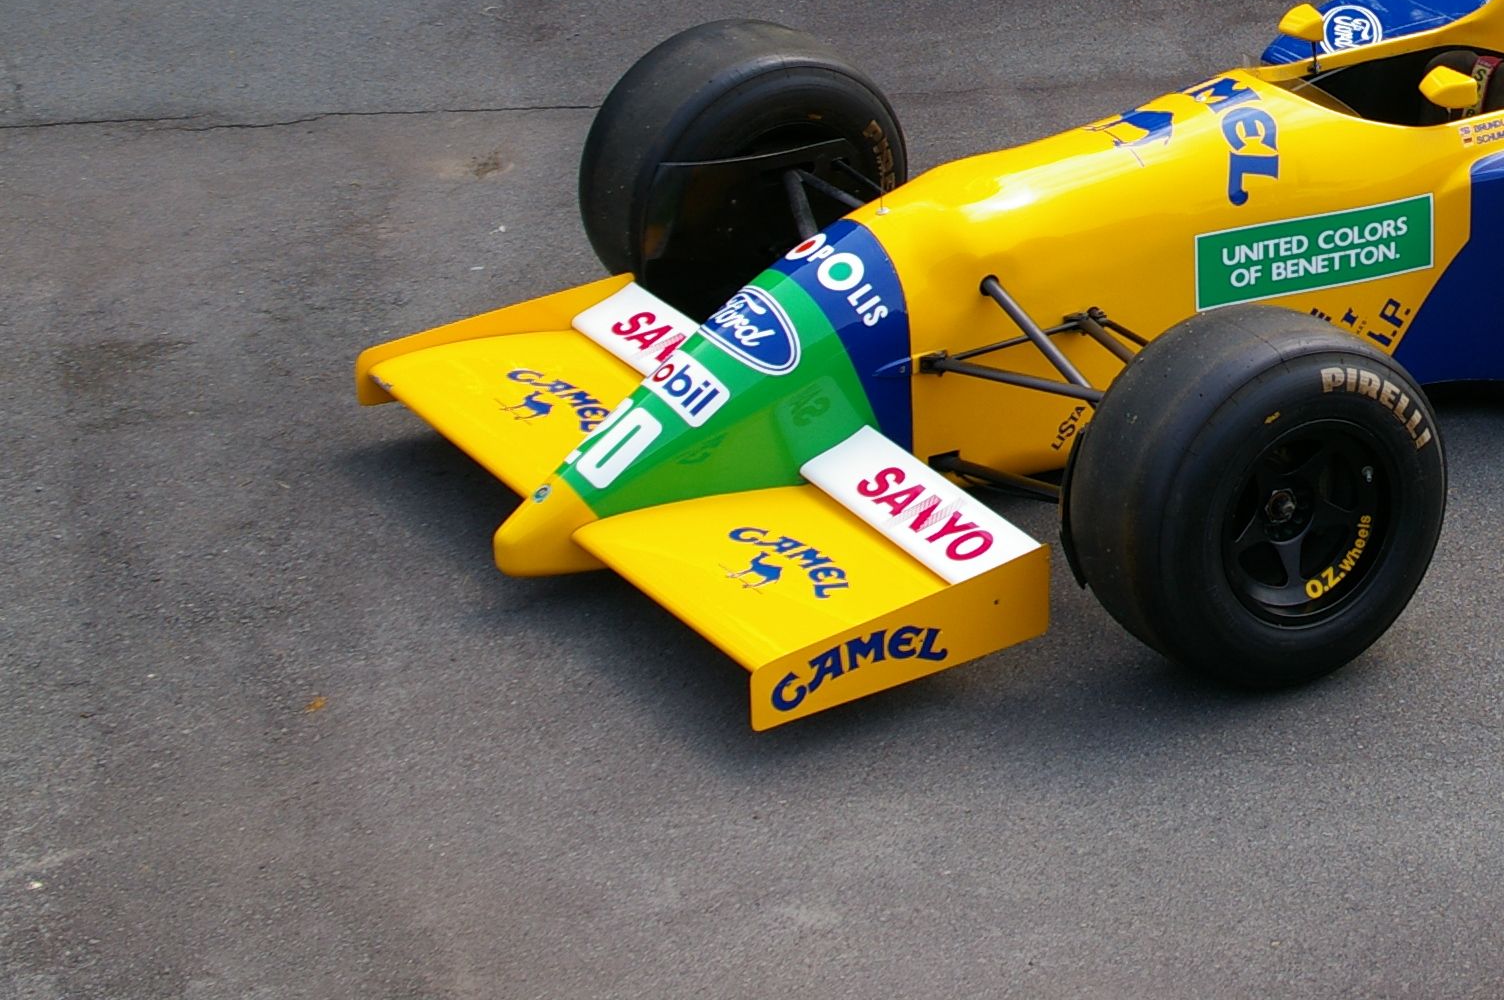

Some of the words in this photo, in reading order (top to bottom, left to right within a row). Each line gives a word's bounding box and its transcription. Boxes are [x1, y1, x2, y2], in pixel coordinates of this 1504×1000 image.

[1188, 77, 1280, 208] MEL
[1221, 235, 1310, 267] UNITED
[1318, 215, 1408, 251] COLORS
[1230, 264, 1261, 288] OF
[1271, 242, 1401, 282] BENETTON.
[784, 233, 889, 328] OPOLIS
[611, 311, 687, 363] SAN
[709, 292, 777, 347] Ford
[506, 368, 611, 433] CAMEL
[652, 363, 721, 418] obil
[1320, 367, 1432, 451] PIRELLI
[1050, 405, 1086, 451] LISTA
[855, 466, 994, 562] SANYO
[728, 525, 851, 600] CAMEL
[770, 624, 949, 711] CAMEL
